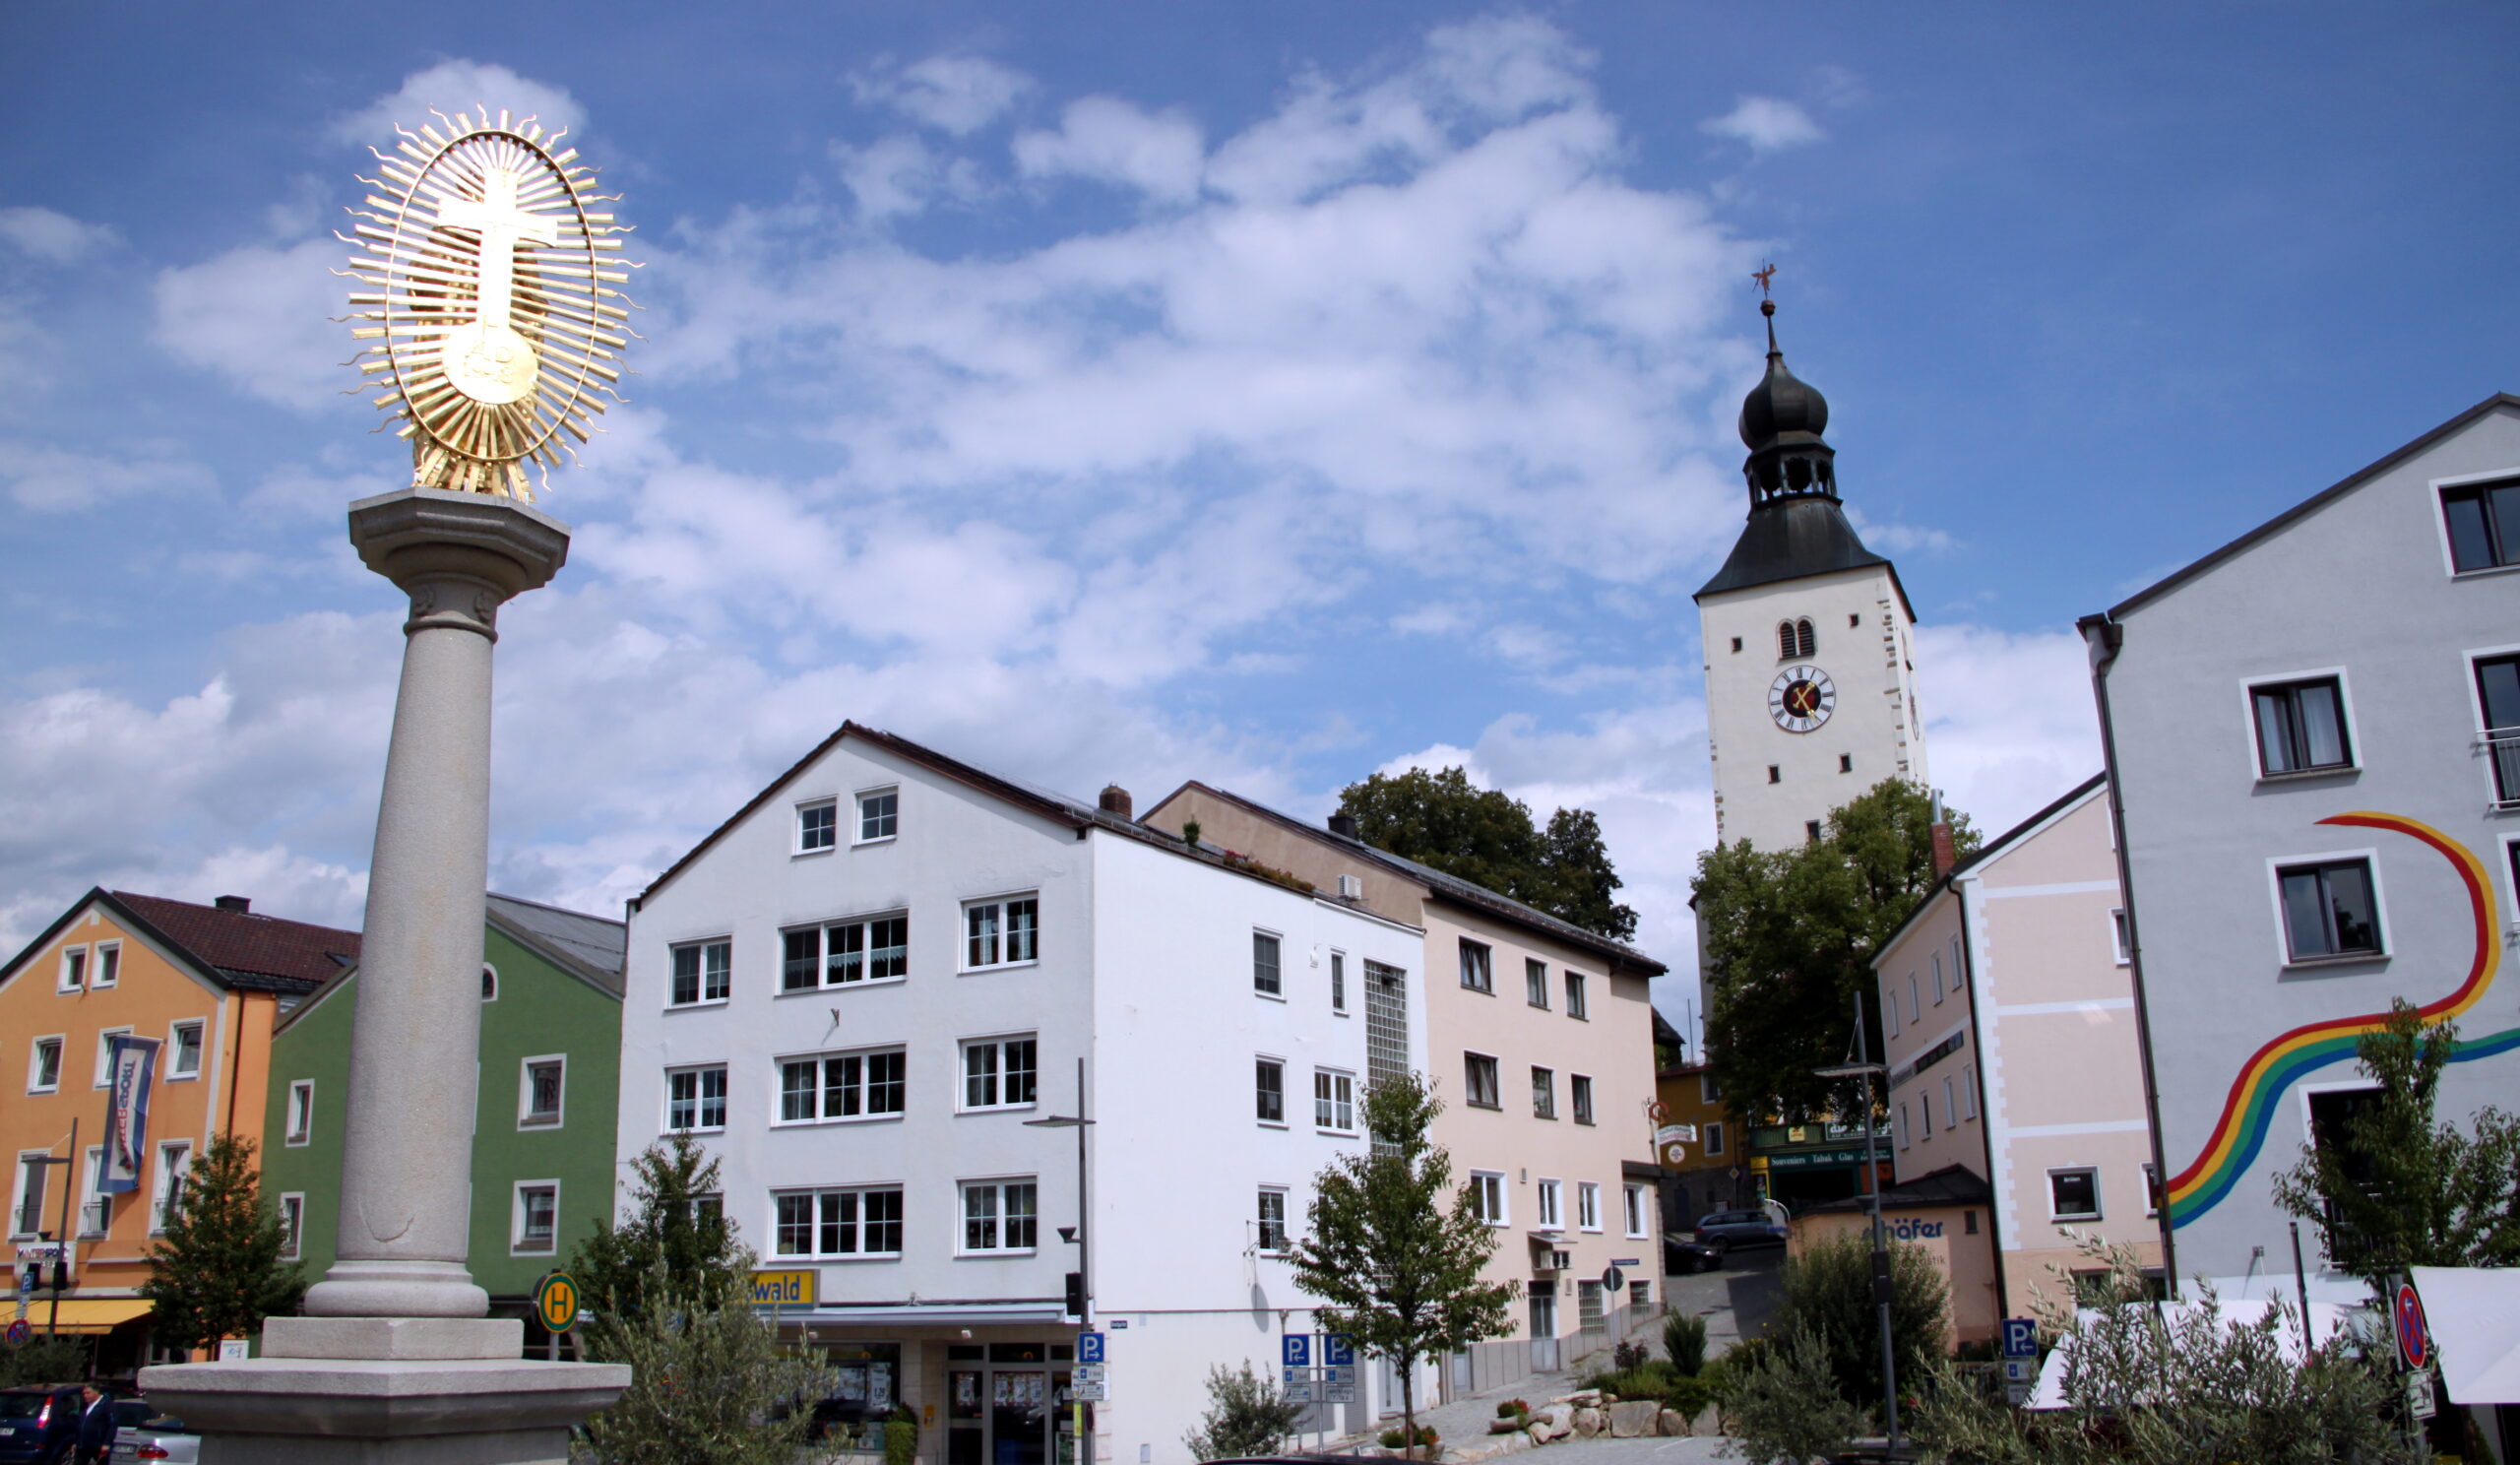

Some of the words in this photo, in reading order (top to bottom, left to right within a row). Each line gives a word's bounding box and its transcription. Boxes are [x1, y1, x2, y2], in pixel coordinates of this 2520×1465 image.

[1812, 1153, 1833, 1163] Tabak
[1838, 1152, 1854, 1162] Glas
[1862, 1218, 1943, 1241] häfer
[23, 1274, 31, 1289] P
[748, 1275, 800, 1301] wald
[551, 1287, 568, 1318] H
[1084, 1336, 1099, 1359] P
[1288, 1337, 1303, 1363] P
[1331, 1336, 1347, 1362] P
[2010, 1323, 2028, 1353] P
